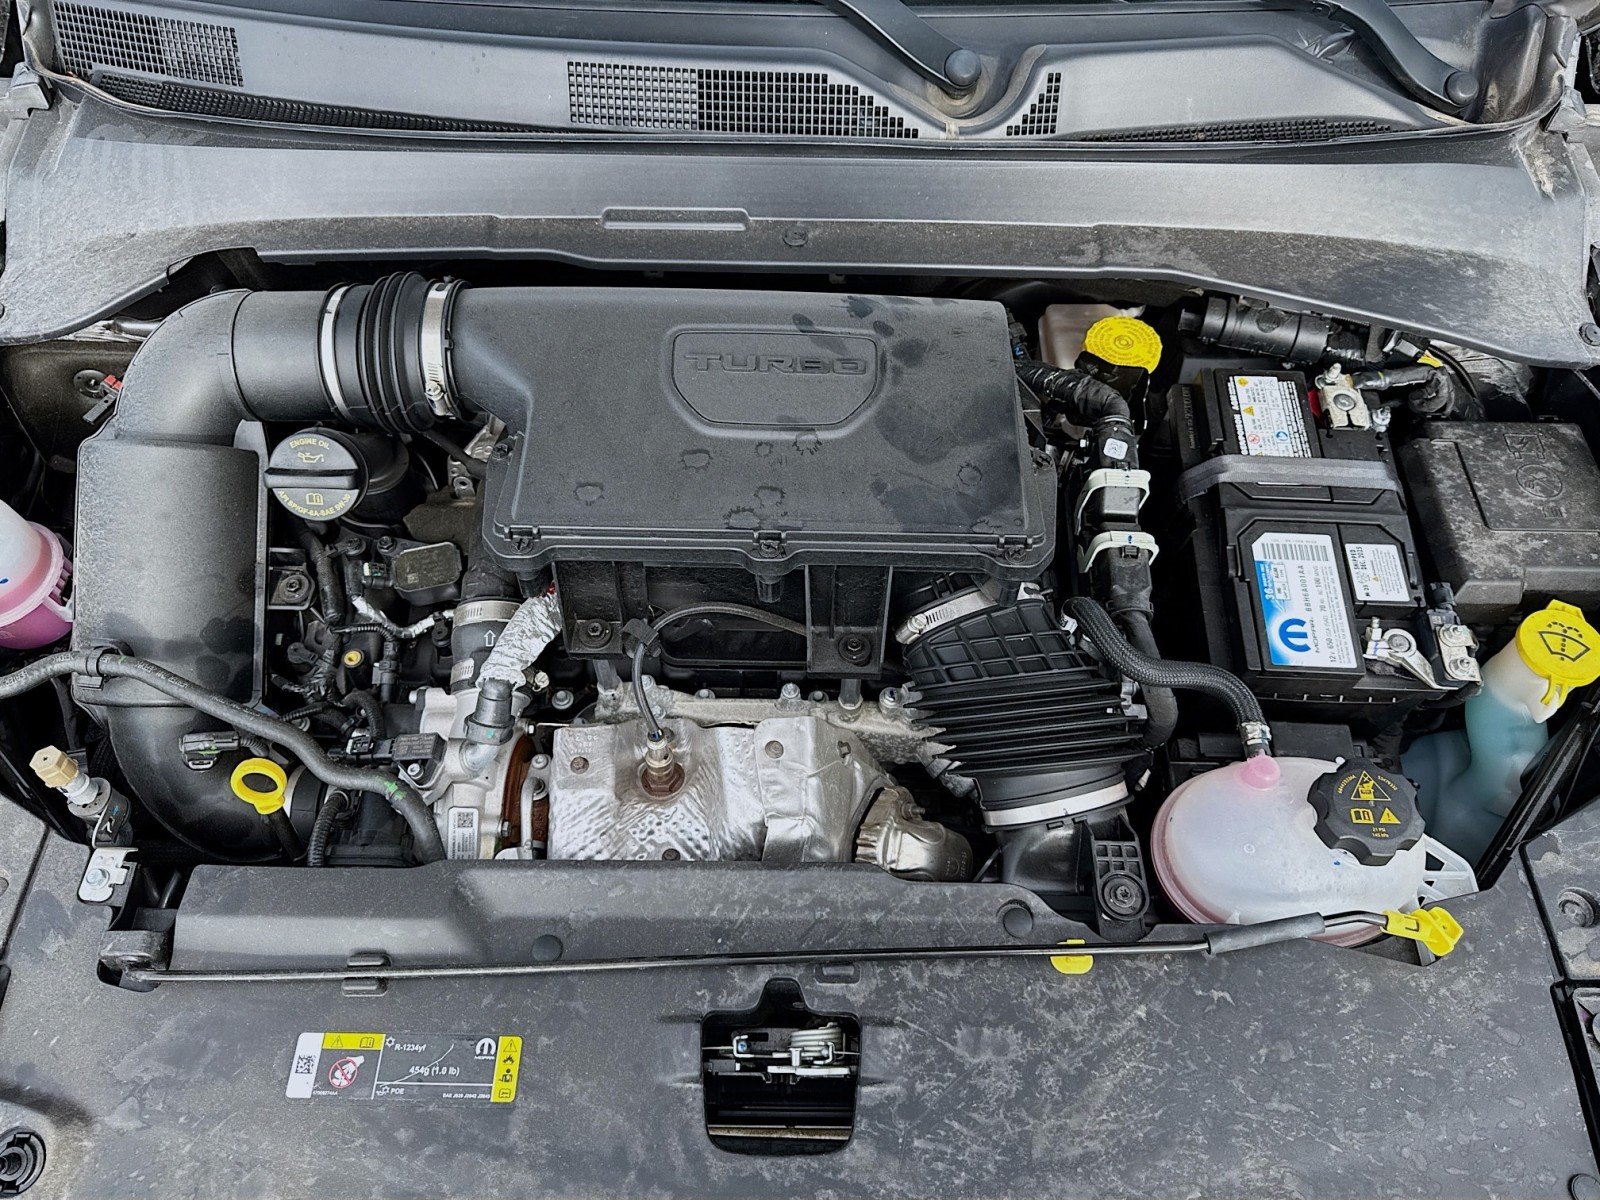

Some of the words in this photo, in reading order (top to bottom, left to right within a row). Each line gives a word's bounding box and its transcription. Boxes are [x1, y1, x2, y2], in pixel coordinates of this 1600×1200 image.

[685, 353, 866, 375] TURBO
[290, 438, 316, 448] ENGINE
[318, 440, 330, 450] OIL
[1350, 550, 1360, 569] SHIPPED
[1313, 577, 1321, 587] 100
[1264, 588, 1274, 599] 36
[1311, 617, 1319, 653] MOPAR
[1325, 637, 1334, 649] 650
[394, 1044, 426, 1052] R-1234yf
[409, 1066, 429, 1076] 454g
[432, 1066, 447, 1076] (1.0
[449, 1066, 460, 1076] lb)
